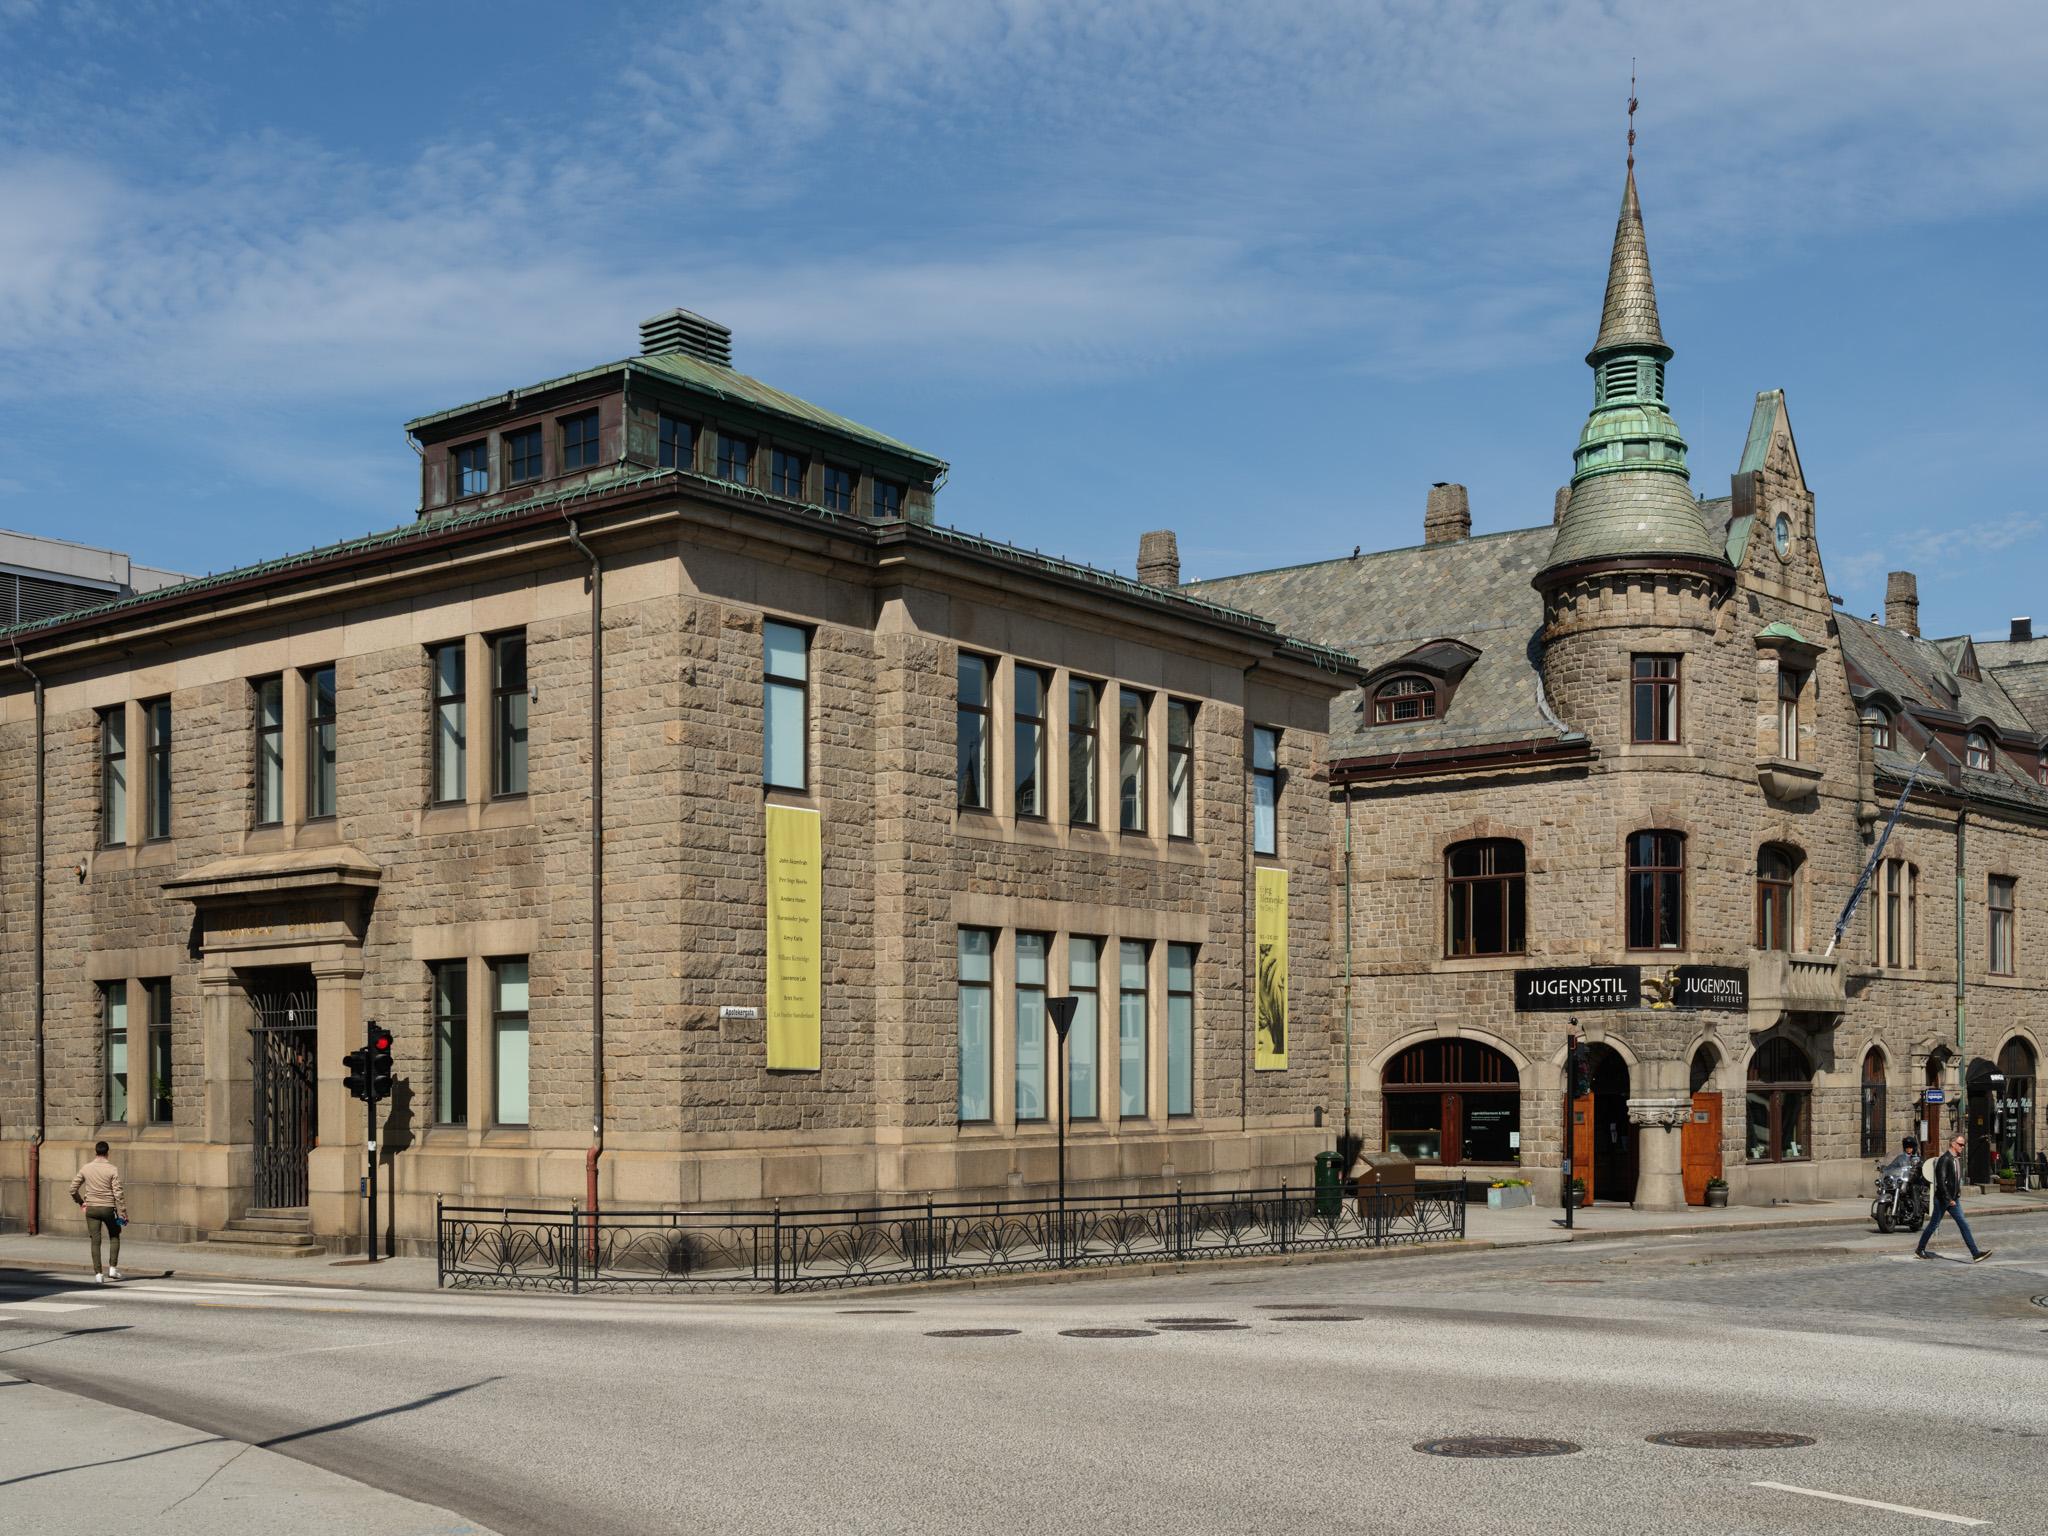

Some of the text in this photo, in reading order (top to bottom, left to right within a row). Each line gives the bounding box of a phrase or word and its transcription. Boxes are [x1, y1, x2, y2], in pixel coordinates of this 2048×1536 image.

[1528, 978, 1628, 996] JUGENDSTIL
[1684, 977, 1743, 995] JUGENDSTIL
[1569, 994, 1628, 1004] SENTERET
[1712, 995, 1743, 1004] SENTERET
